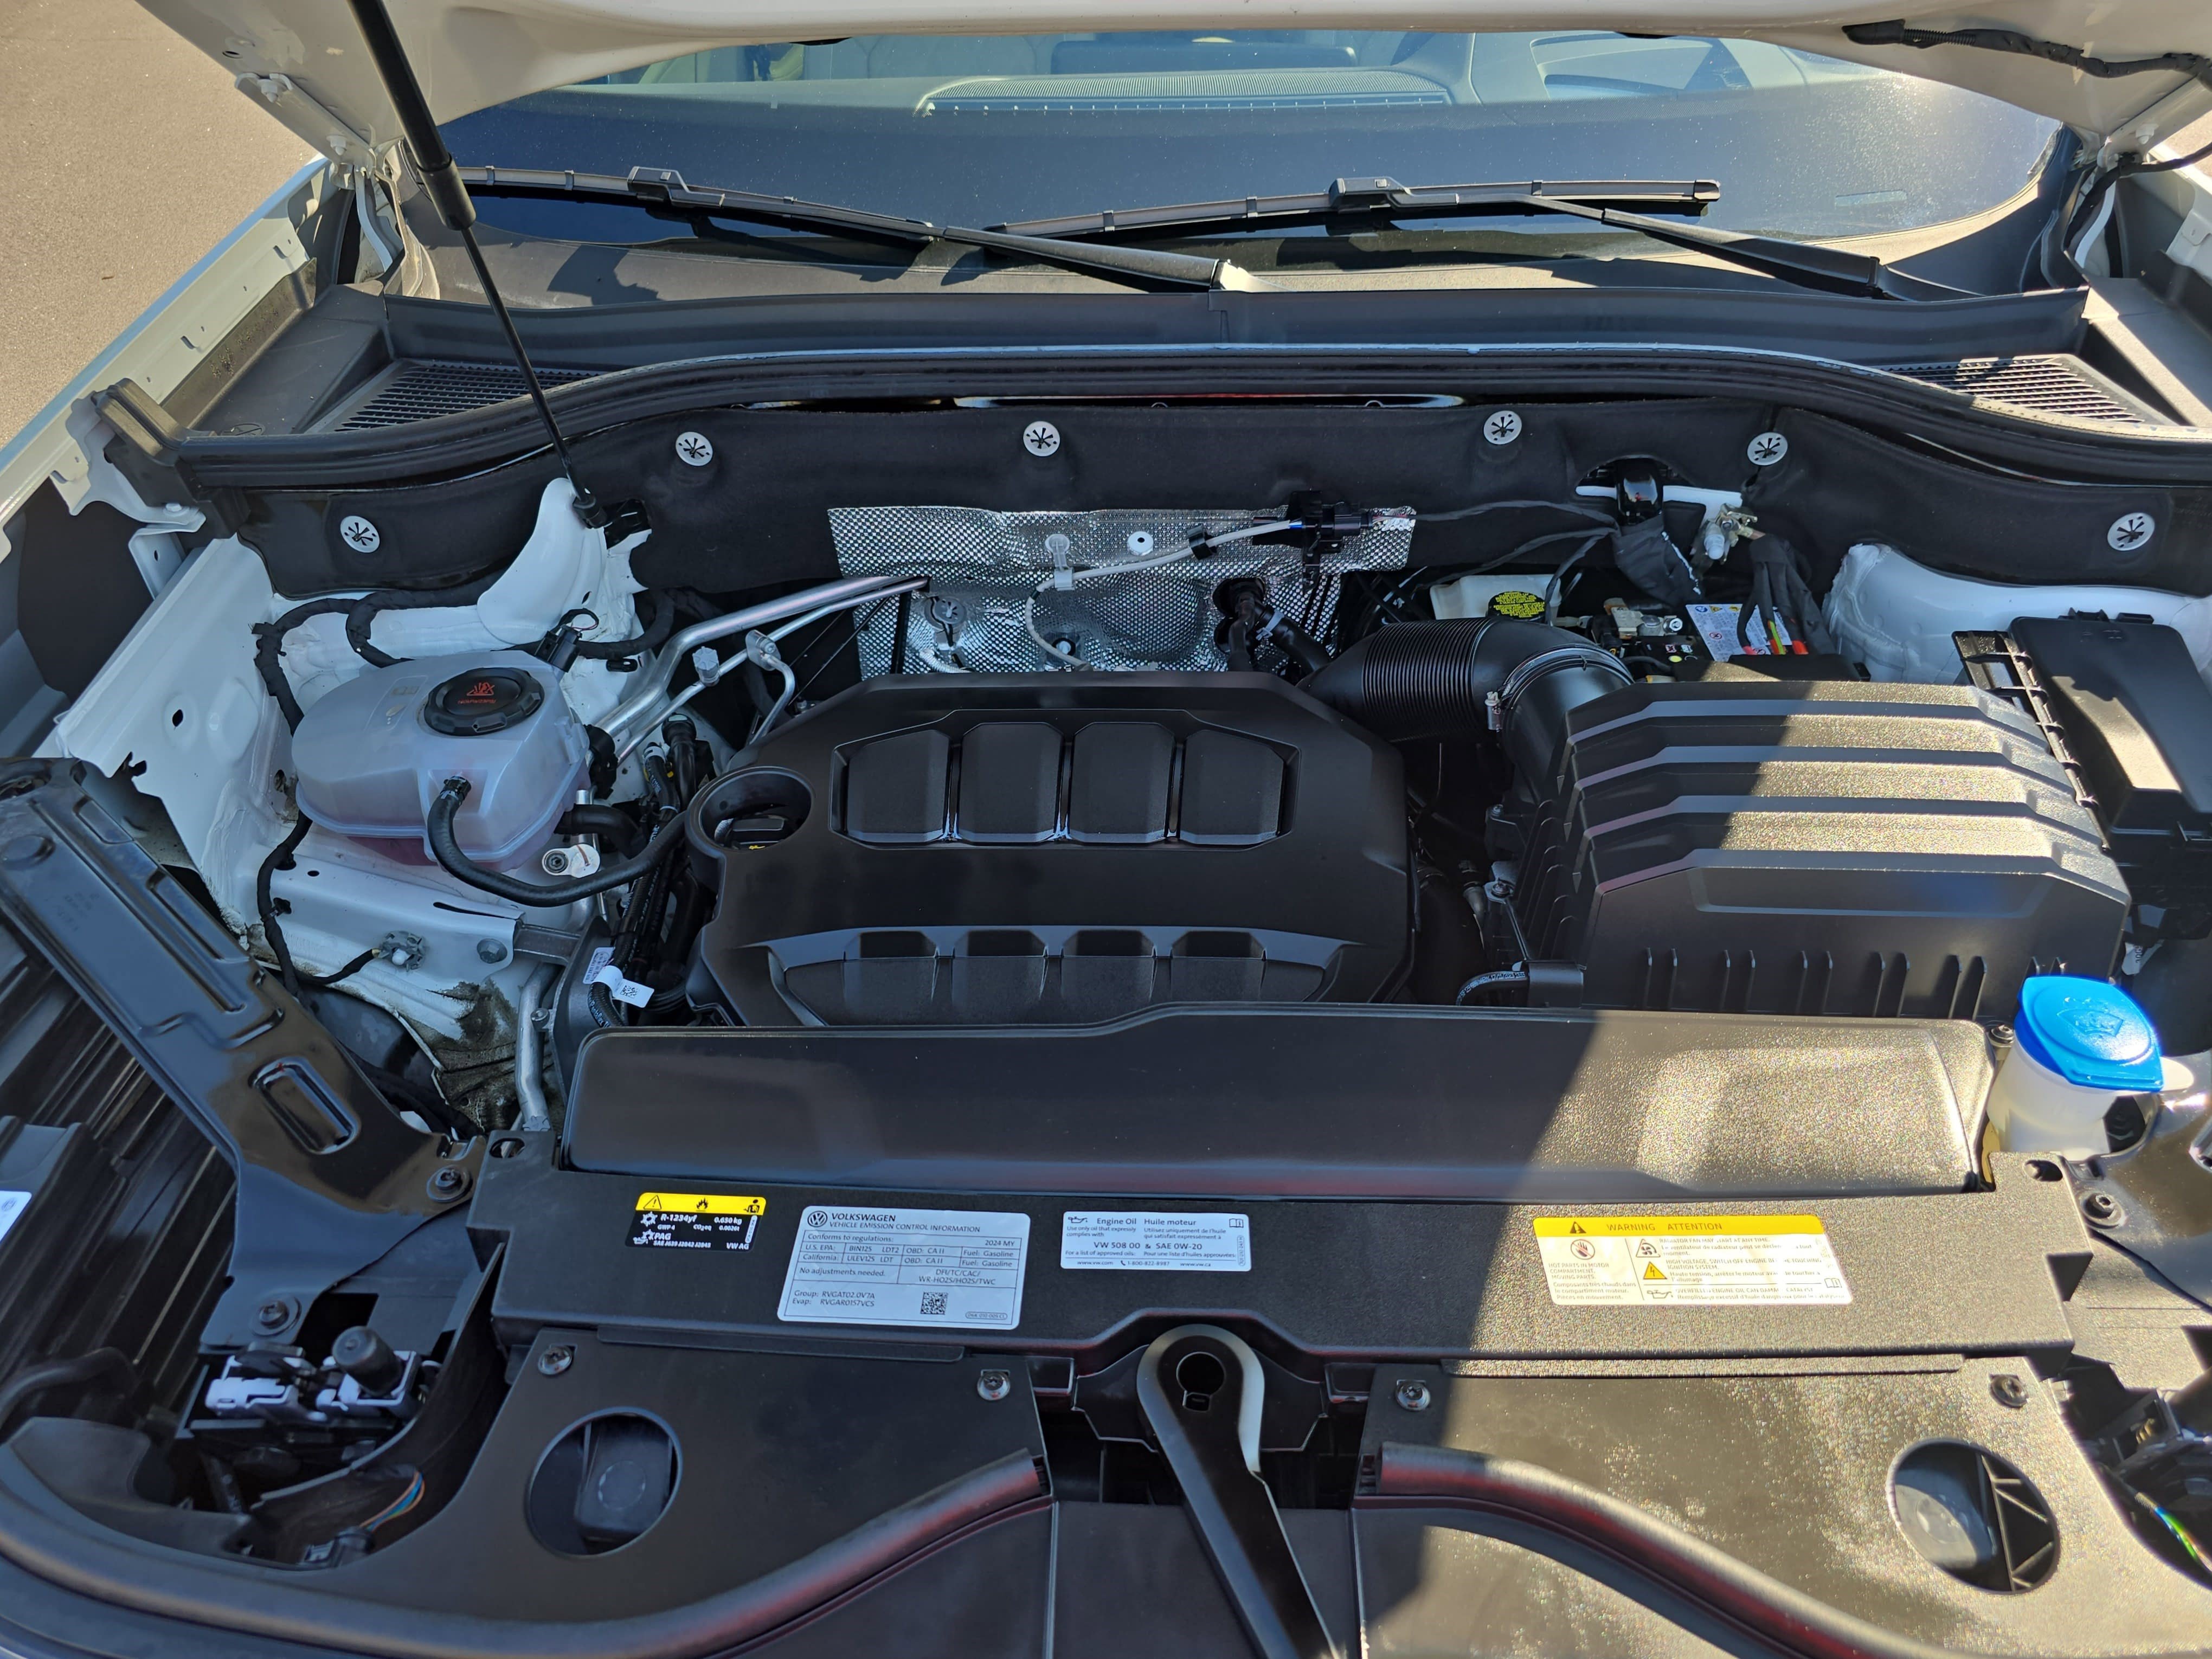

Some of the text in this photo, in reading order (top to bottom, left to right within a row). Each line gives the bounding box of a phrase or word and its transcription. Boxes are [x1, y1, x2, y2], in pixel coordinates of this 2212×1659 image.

[660, 1213, 697, 1223] R-1234yf
[734, 1217, 742, 1225] kg
[831, 1212, 896, 1222] VOLKSWAGEN
[1097, 1218, 1124, 1226] Engine
[1668, 1223, 1723, 1231] ATTENTION
[654, 1232, 671, 1240] PAG
[811, 1268, 856, 1276] adjustments
